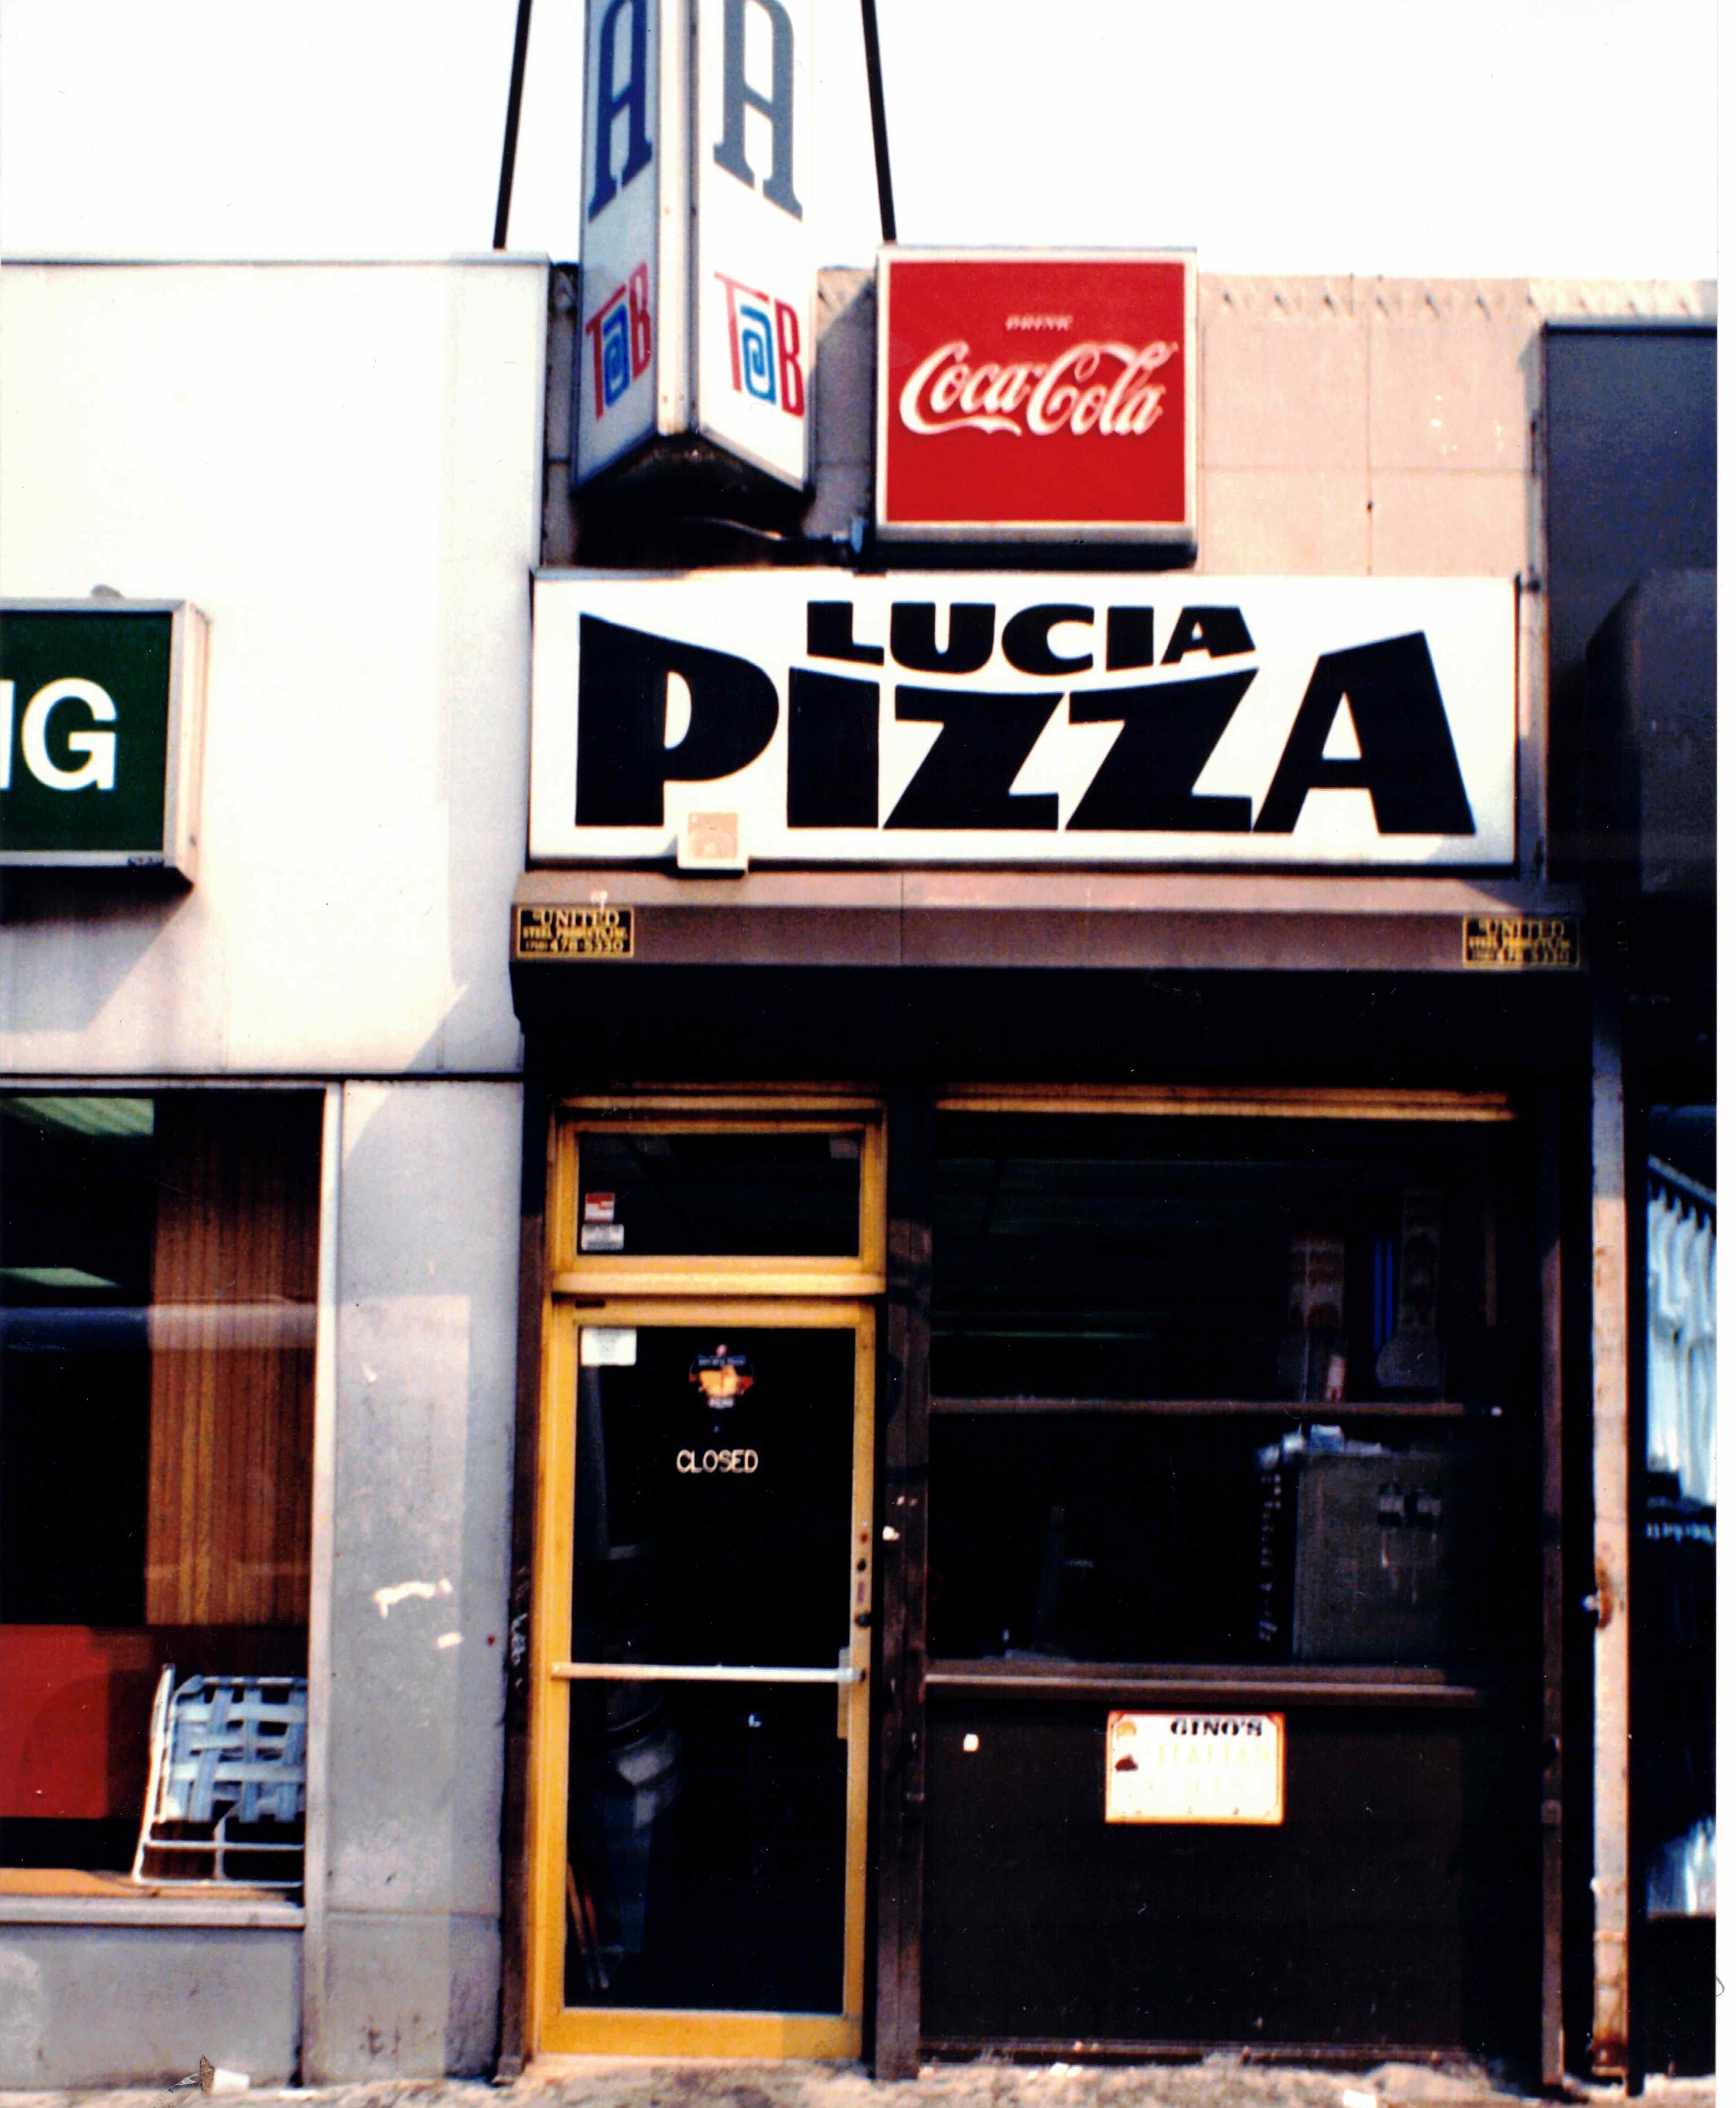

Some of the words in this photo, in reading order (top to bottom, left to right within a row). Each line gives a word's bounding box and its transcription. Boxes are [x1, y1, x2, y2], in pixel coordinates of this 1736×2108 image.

[899, 340, 1178, 436] Coca-Cola
[807, 601, 1257, 676] LUCIA
[575, 613, 1476, 834] PIZZA
[676, 1449, 759, 1474] CLOSED
[1170, 1717, 1262, 1736] GINO'S
